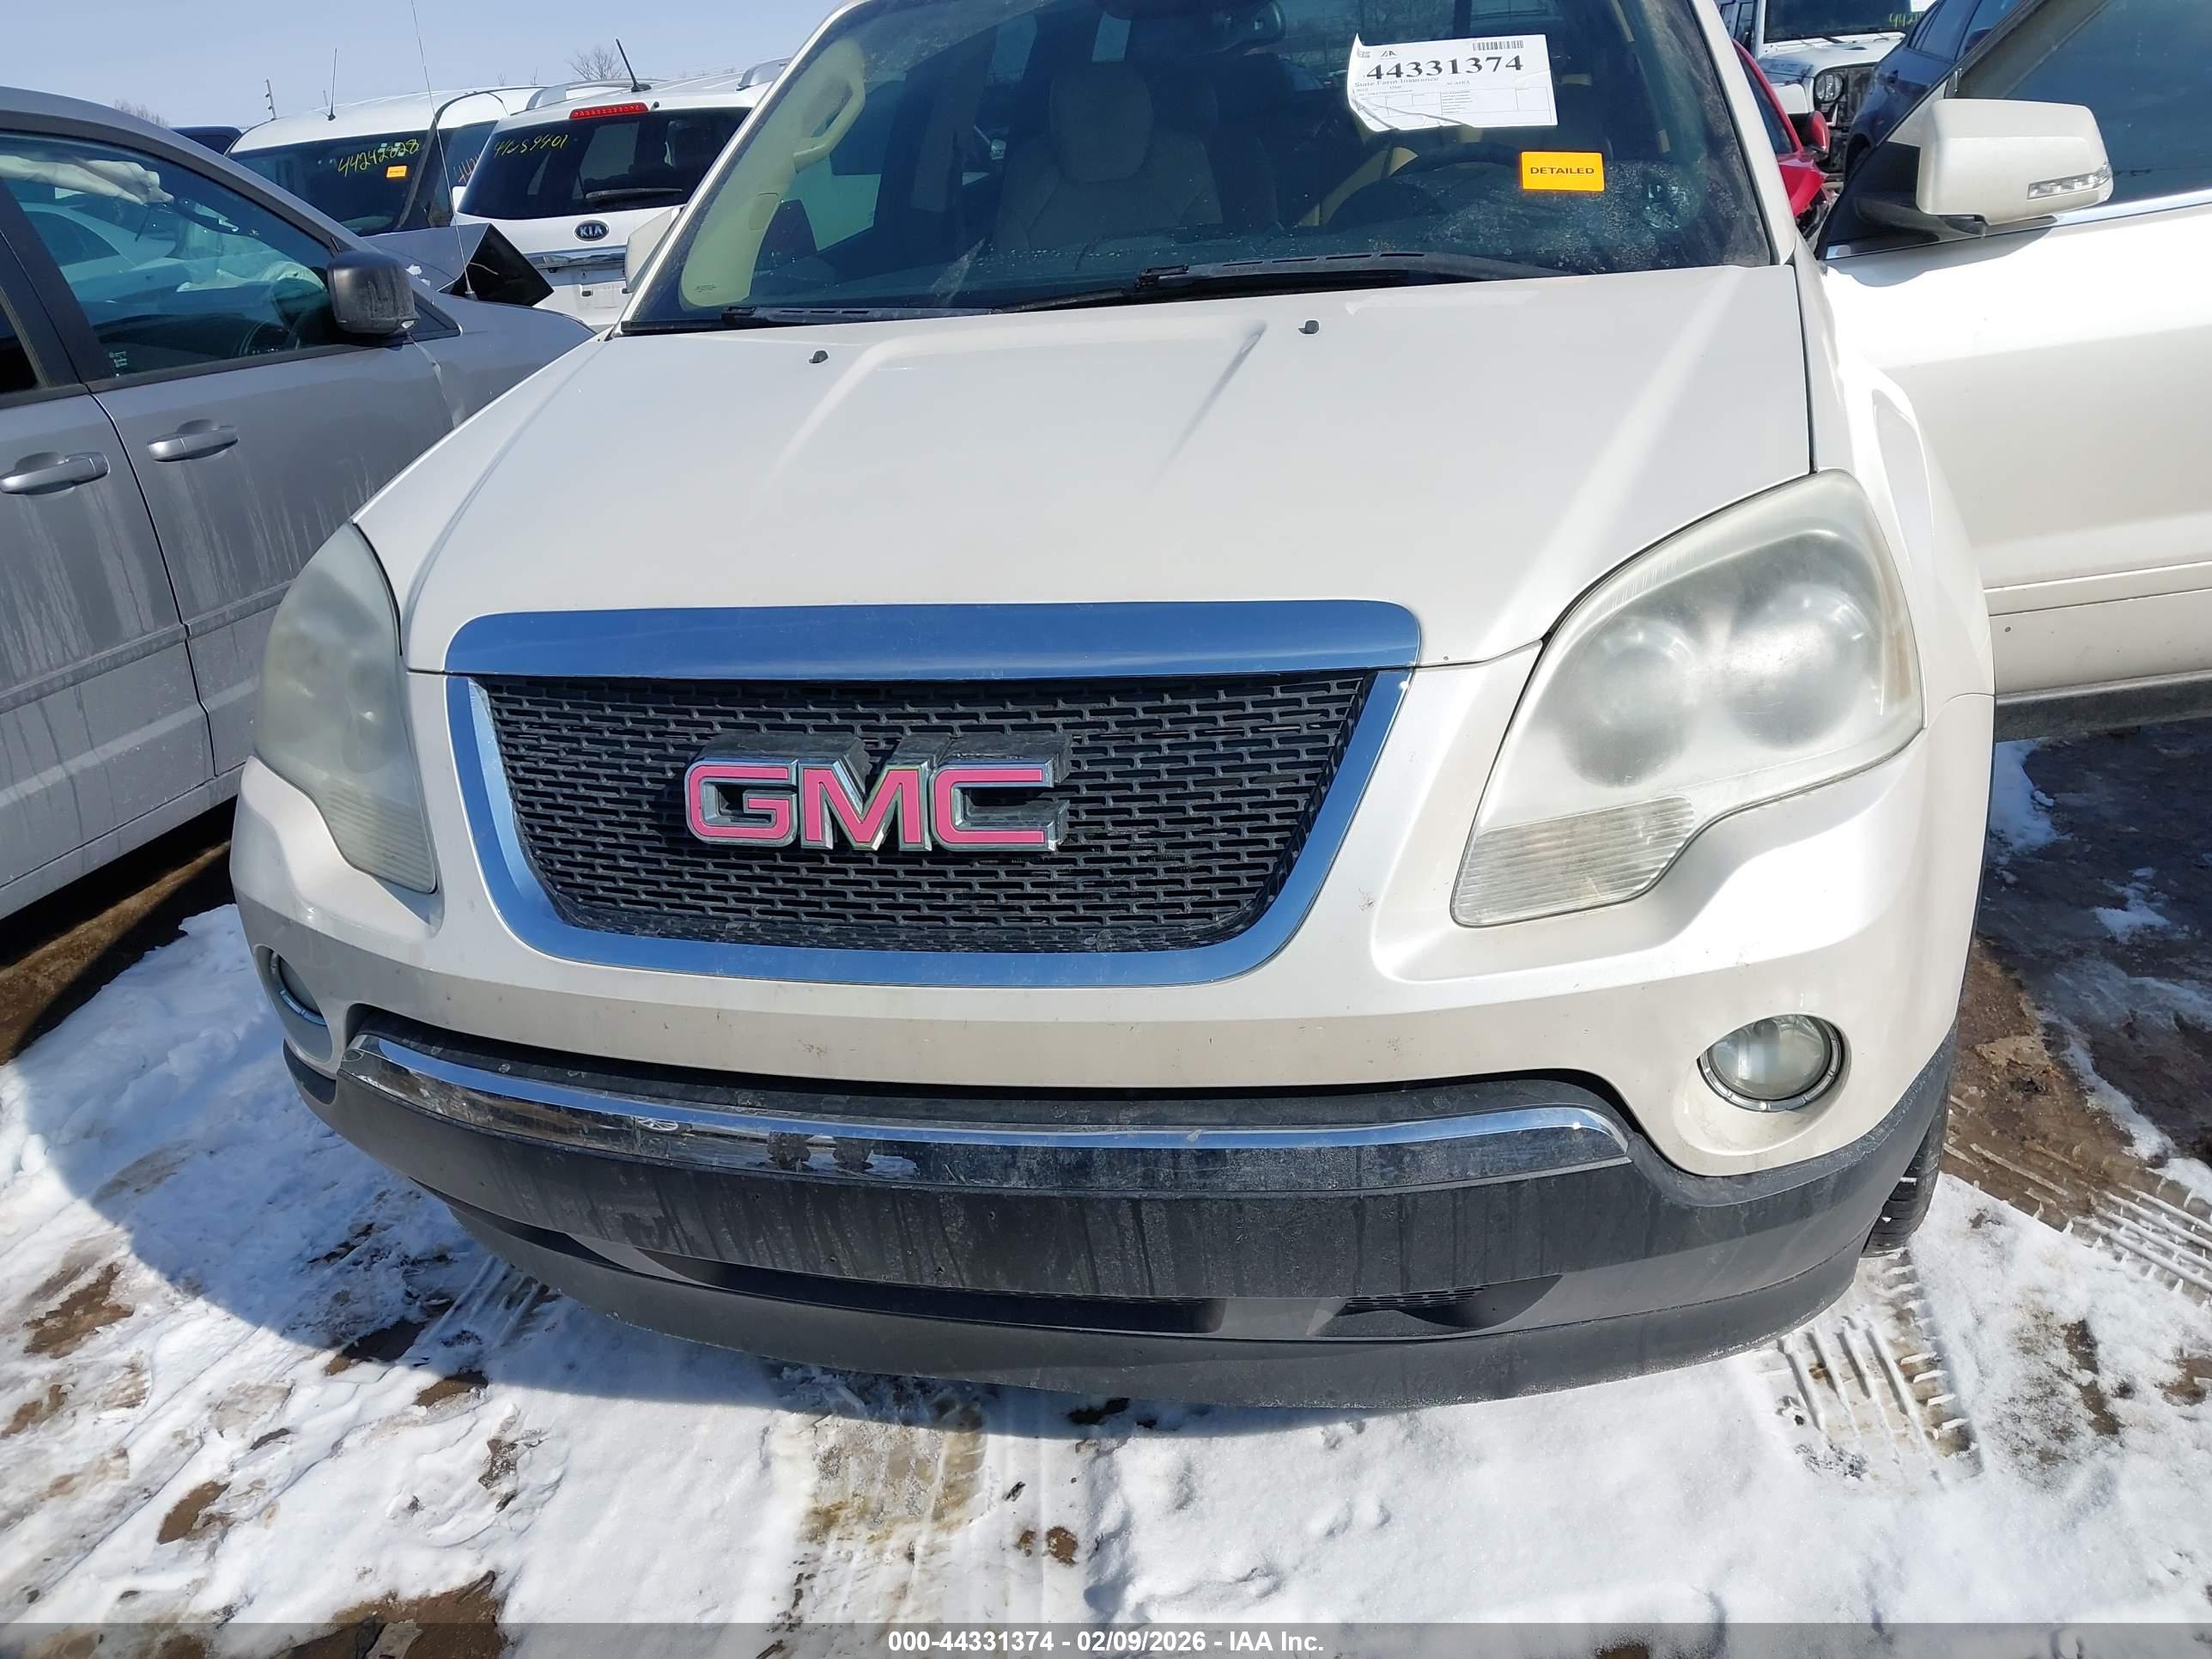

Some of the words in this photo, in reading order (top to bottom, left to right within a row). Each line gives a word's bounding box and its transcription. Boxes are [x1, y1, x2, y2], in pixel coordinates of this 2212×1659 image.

[1366, 54, 1523, 80] 44331374
[337, 138, 420, 178] 44242828
[580, 225, 603, 237] KIA
[684, 756, 1060, 852] GMC
